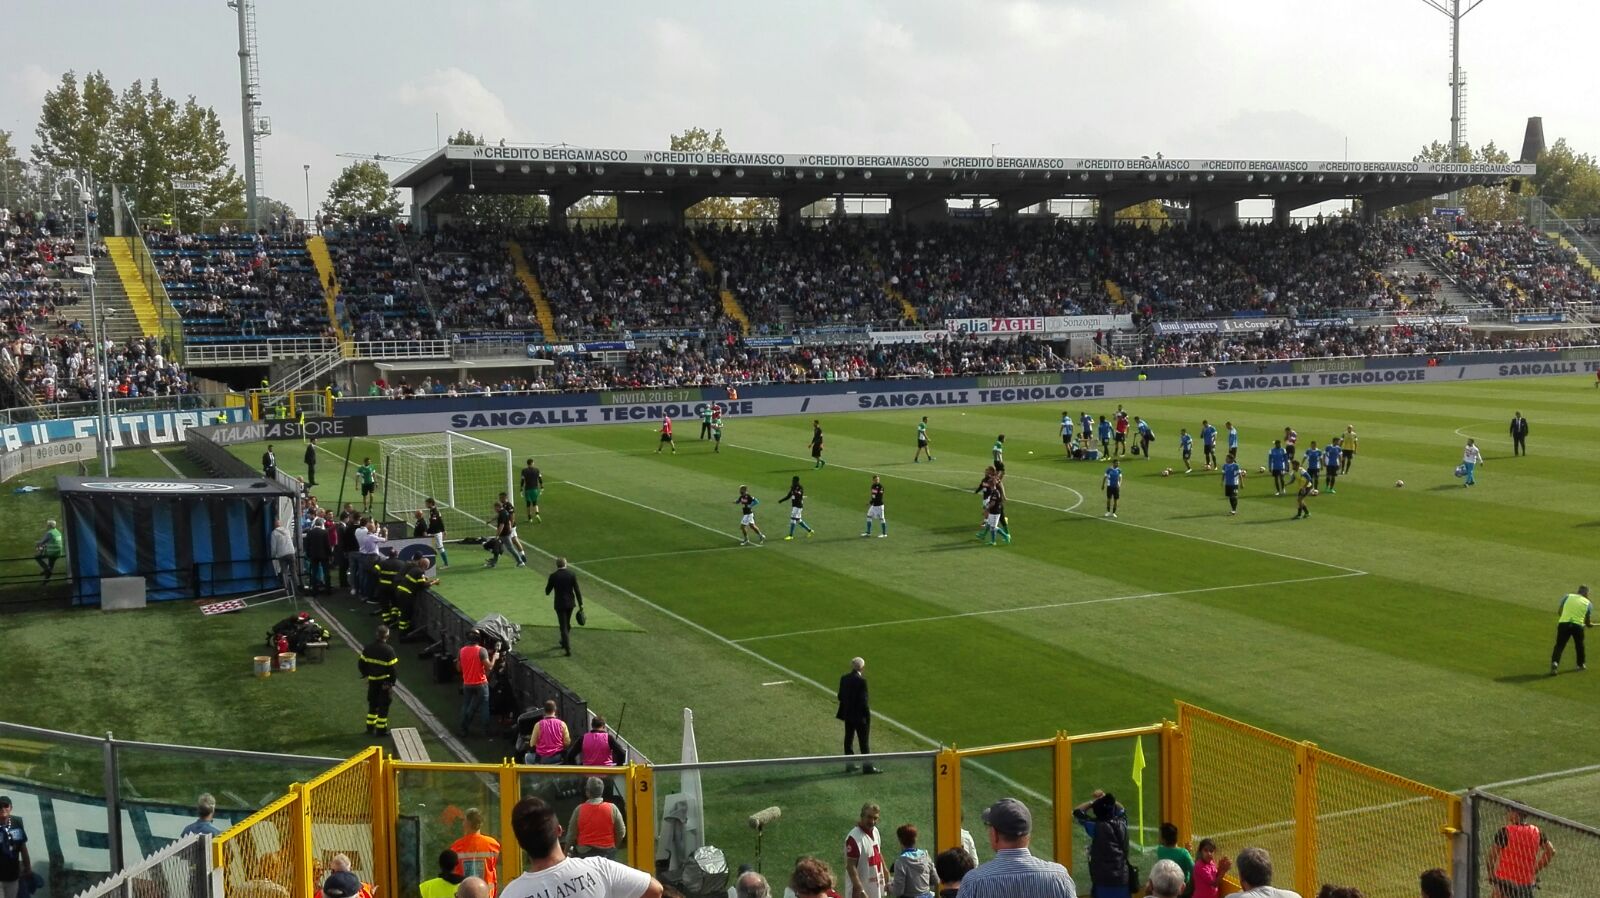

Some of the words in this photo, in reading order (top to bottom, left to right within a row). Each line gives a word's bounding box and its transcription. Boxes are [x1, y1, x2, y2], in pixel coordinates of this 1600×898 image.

[484, 147, 540, 159] CREDITO
[543, 149, 628, 161] BERGAMASCO
[653, 152, 704, 163] CREDITO
[706, 153, 785, 165] BERGAMASCO
[808, 155, 855, 166] CREDITO
[857, 156, 929, 167] BERGAMASCO
[951, 157, 994, 168] CREDITO
[996, 158, 1064, 169] BERGAMASCO
[1084, 159, 1125, 169] CREDITO
[1126, 160, 1190, 170] BERGAMASCO
[1209, 160, 1247, 170] CREDITO
[1248, 161, 1309, 171] BERGAMASCO
[1325, 162, 1361, 171] CREDITO
[1363, 162, 1419, 172] BERGAMASCO
[1434, 164, 1469, 172] CREDITO
[1469, 164, 1522, 173] BERGAMASCO
[1063, 317, 1100, 328] Sonzogni
[1498, 362, 1577, 377] SANGALLI
[1217, 374, 1310, 390] SANGALLI
[1318, 369, 1426, 386] TECNOLOGIE
[648, 391, 690, 402] 2016-17
[858, 391, 969, 409] SANGALLI
[978, 384, 1105, 402] TECNOLOGIE
[451, 408, 588, 428] SANGALLI
[211, 422, 281, 442] ATALANTA
[284, 420, 344, 436] STORE
[940, 764, 948, 775] 2
[640, 780, 648, 792] 3
